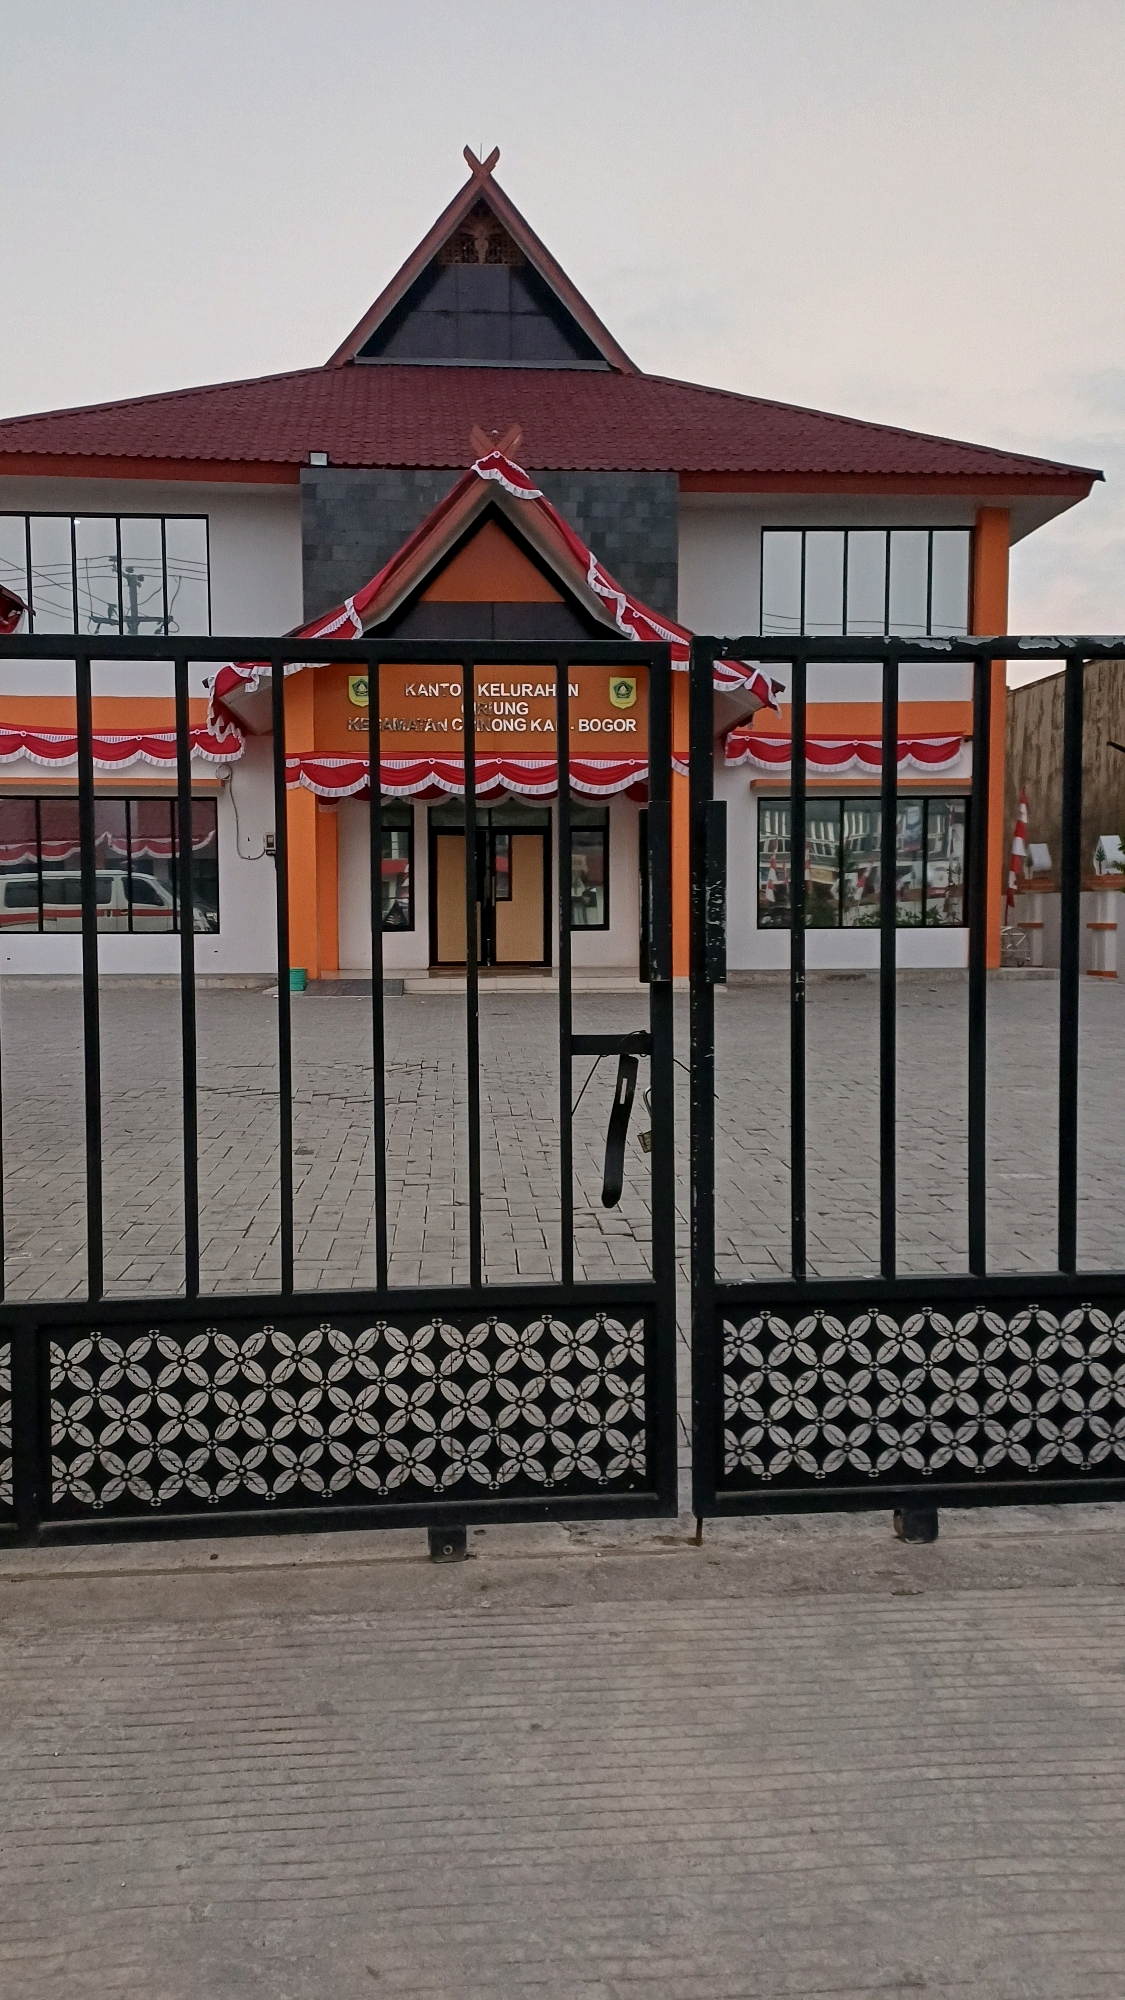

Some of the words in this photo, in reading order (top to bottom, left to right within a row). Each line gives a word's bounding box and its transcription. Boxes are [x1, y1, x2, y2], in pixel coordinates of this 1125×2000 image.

[405, 683, 473, 697] KANTO
[478, 683, 579, 697] KELURAHN
[461, 701, 529, 715] IRIUNG
[348, 717, 448, 732] KEAMATAN
[451, 718, 527, 732] CINONG
[578, 718, 637, 732] BOGOR
